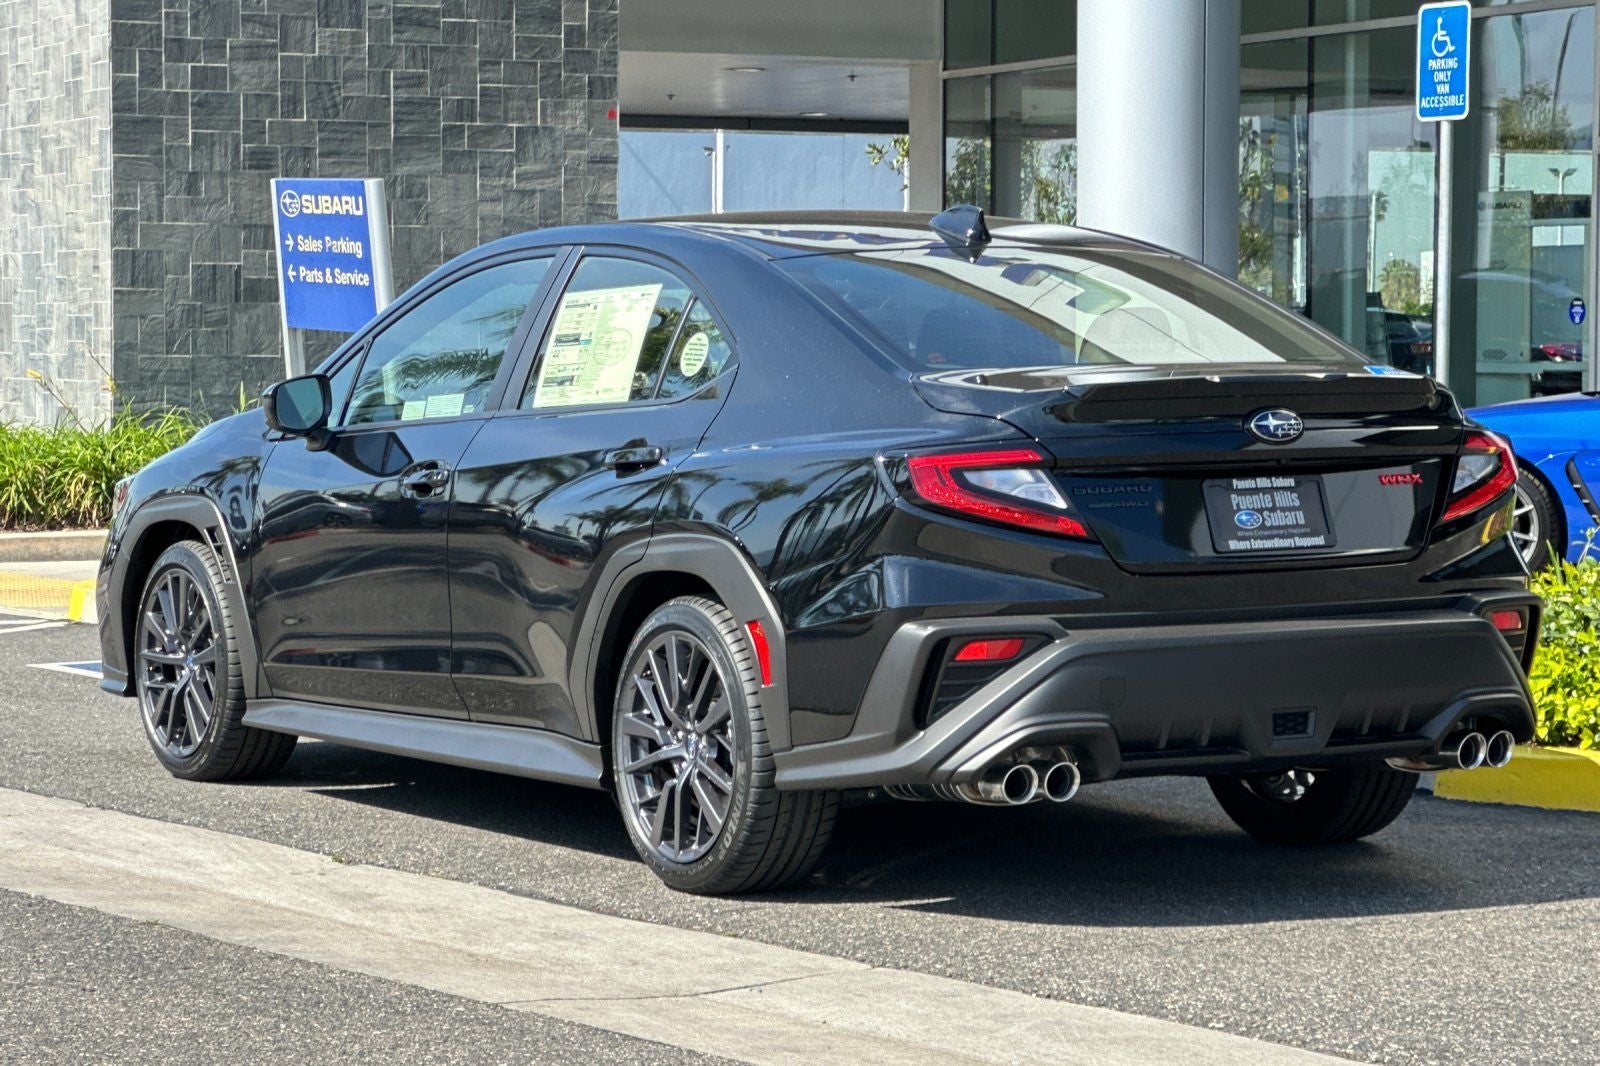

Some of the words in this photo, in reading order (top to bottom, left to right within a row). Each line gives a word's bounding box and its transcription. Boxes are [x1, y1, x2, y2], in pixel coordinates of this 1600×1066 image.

[1428, 57, 1458, 70] PARKING
[1433, 71, 1452, 82] ONLY
[1436, 83, 1450, 94] VAN
[1421, 94, 1465, 108] ACCESSIBLE
[301, 194, 364, 215] SUBARU
[297, 234, 323, 252] Sales
[325, 236, 363, 258] Parking
[299, 266, 324, 283] Parts
[325, 267, 334, 284] &
[334, 268, 370, 286] Service
[1232, 478, 1256, 489] Puente
[1256, 477, 1272, 488] Hills
[1271, 476, 1295, 487] Subaru
[1378, 473, 1423, 485] WRX
[1073, 485, 1152, 494] SUBARU
[1231, 492, 1272, 510] Puente
[1274, 491, 1300, 507] Hills
[1263, 510, 1305, 527] Subaru
[1229, 540, 1251, 550] Where
[1250, 538, 1295, 549] Extraordinary
